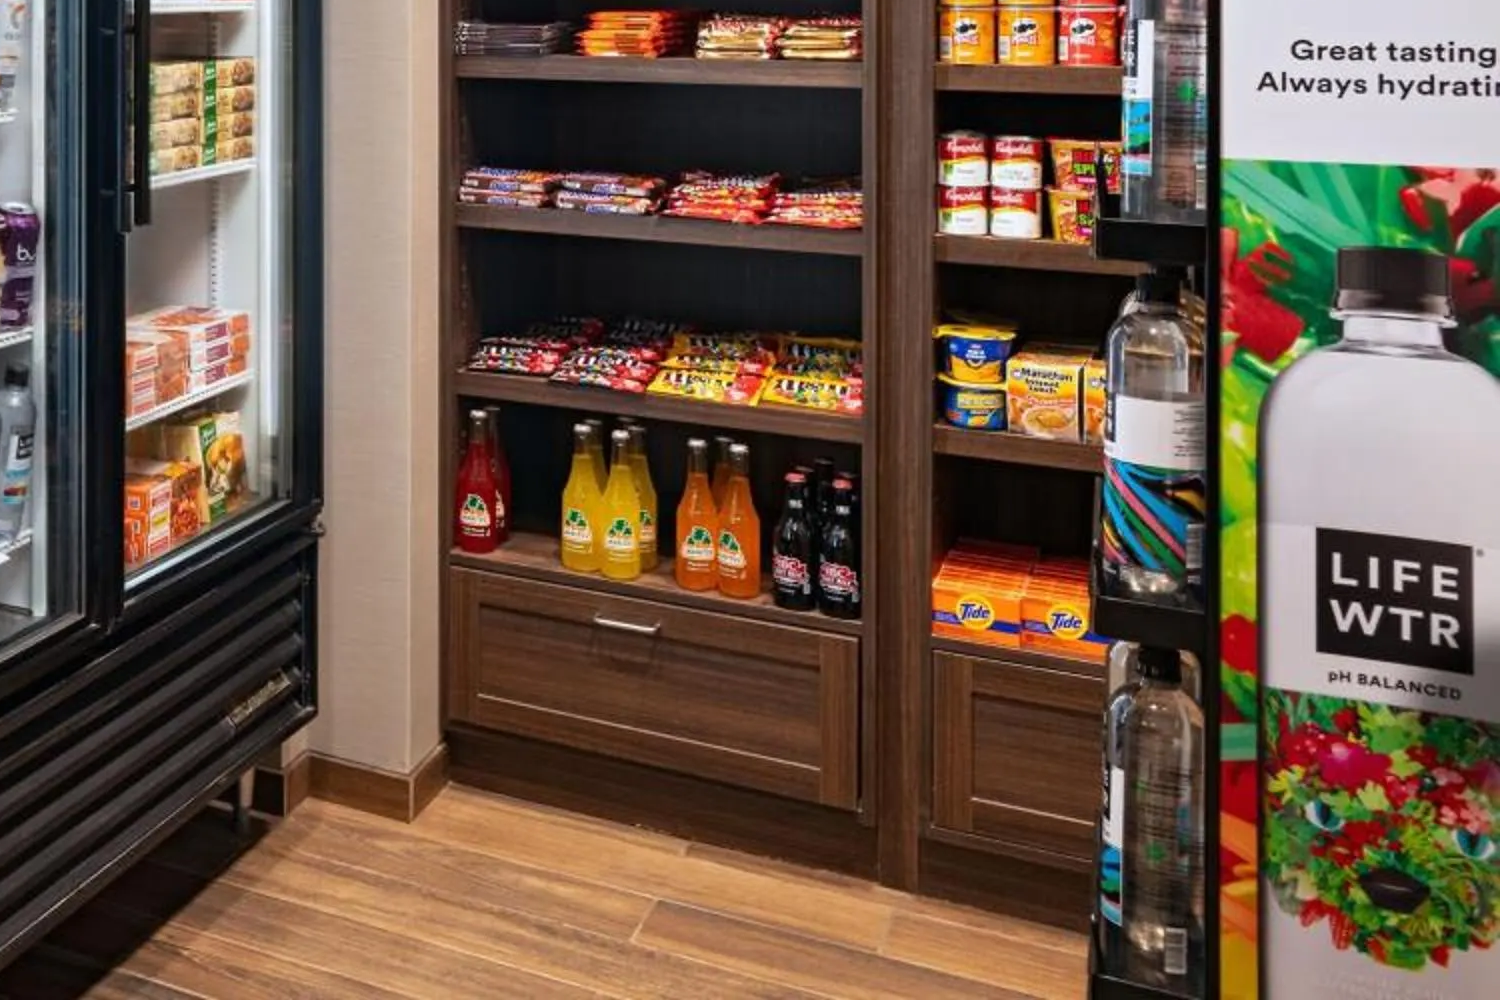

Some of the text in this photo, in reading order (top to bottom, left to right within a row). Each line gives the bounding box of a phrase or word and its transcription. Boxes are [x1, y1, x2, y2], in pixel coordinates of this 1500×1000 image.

[1290, 38, 1498, 69] Great tasting
[1257, 71, 1368, 99] Always
[1331, 551, 1460, 601] LIFE
[959, 602, 992, 621] Tide
[1050, 612, 1083, 630] Tide
[1328, 598, 1461, 650] WTR
[1328, 670, 1462, 701] pH BALANCED
